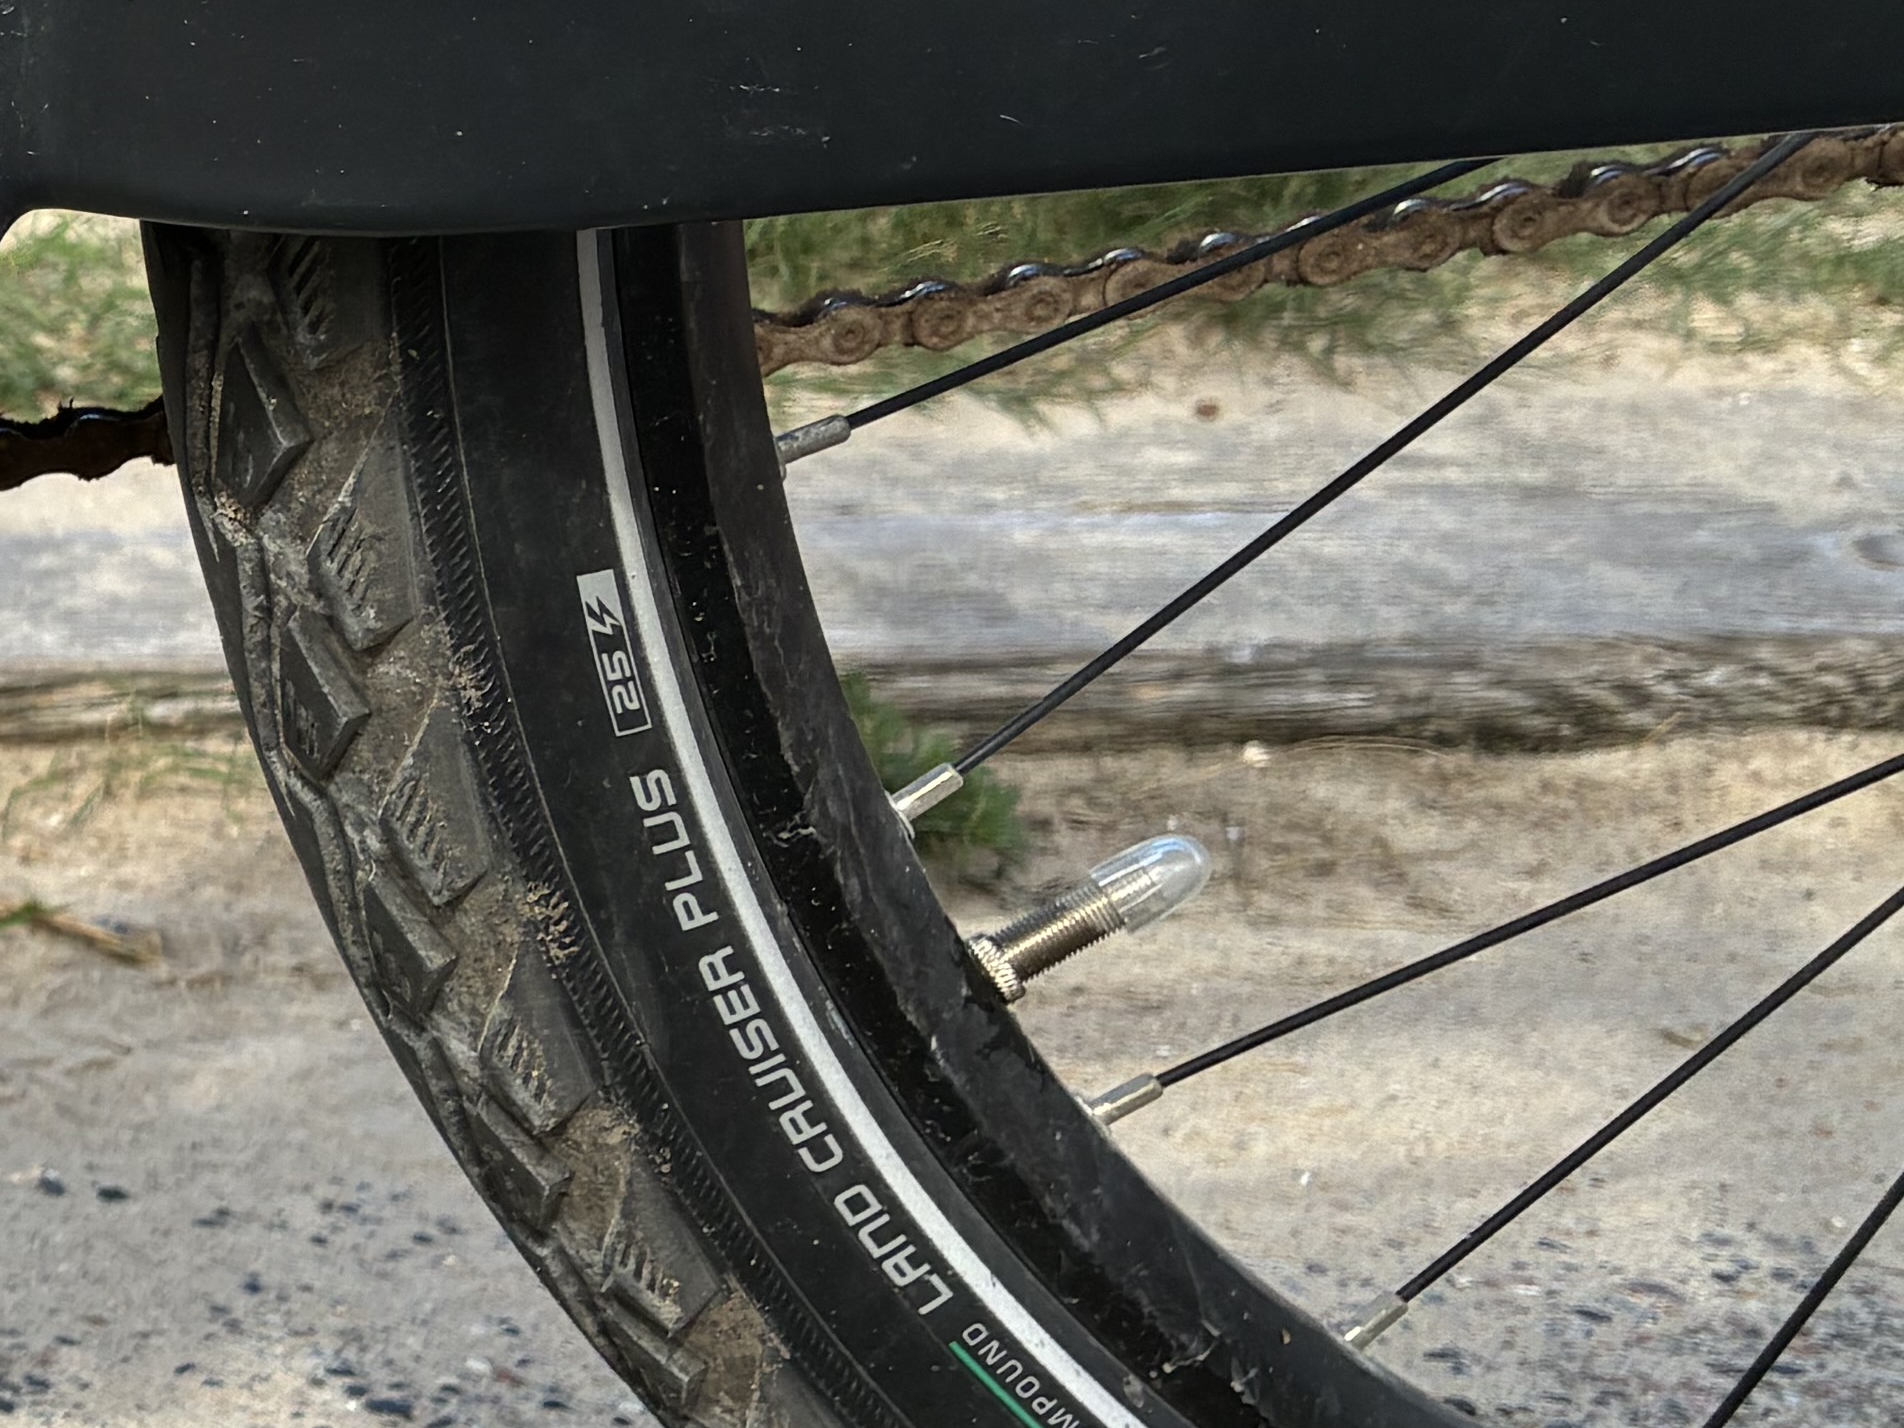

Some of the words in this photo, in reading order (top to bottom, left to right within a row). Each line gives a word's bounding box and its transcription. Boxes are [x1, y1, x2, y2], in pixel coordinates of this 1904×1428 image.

[602, 651, 641, 714] 25
[629, 768, 718, 932] PLUS
[698, 944, 844, 1174] CRUISER
[833, 1184, 954, 1316] LAND
